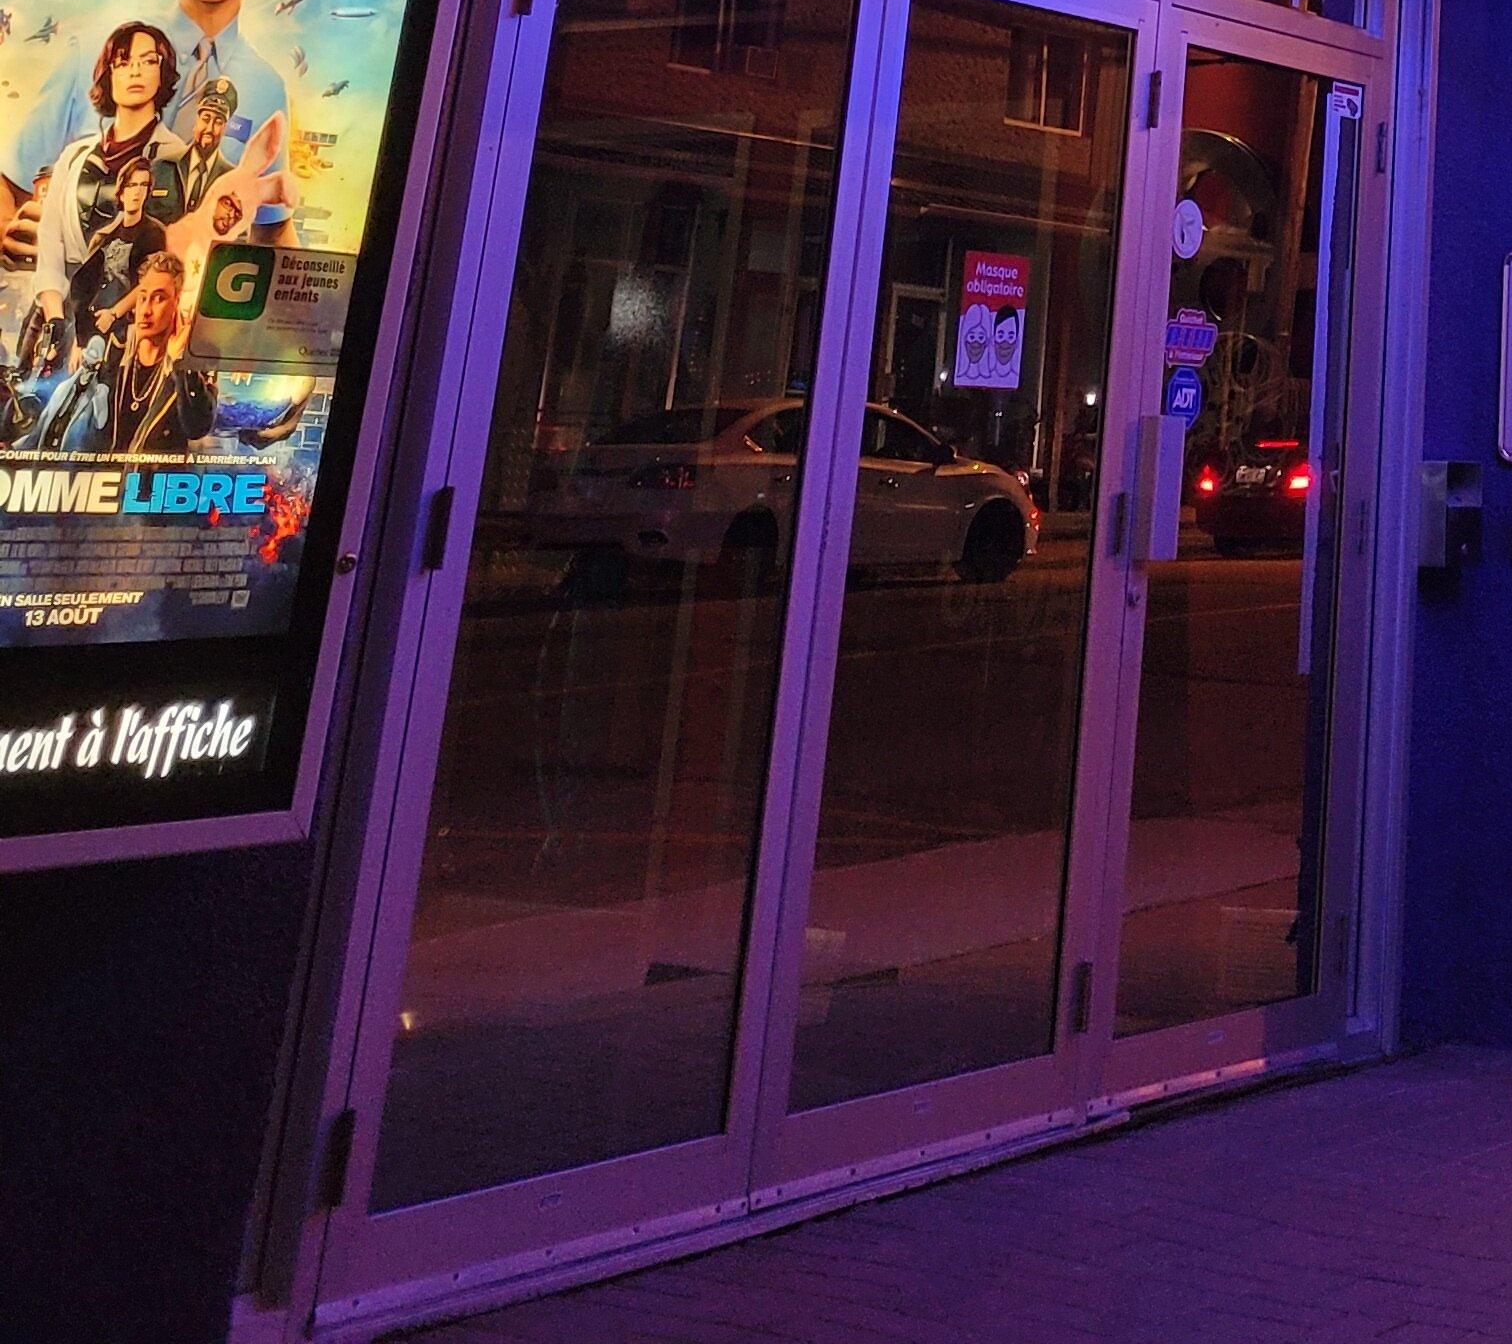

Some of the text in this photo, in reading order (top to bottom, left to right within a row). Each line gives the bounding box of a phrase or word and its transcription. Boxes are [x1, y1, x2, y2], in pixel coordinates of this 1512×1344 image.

[281, 255, 346, 274] Déconseillé
[975, 261, 1018, 280] Masque
[216, 261, 260, 303] G
[278, 273, 339, 290] aux jeunes
[966, 278, 1025, 298] obligatoire
[274, 289, 320, 304] enfants
[1172, 387, 1197, 409] ADT
[41, 451, 69, 462] POUR
[111, 453, 185, 464] PERSONNAGE
[186, 453, 195, 464] À
[122, 472, 267, 514] LIBRE
[0, 591, 144, 607] N SALLE SEULEMENT
[25, 604, 104, 627] 13 AOÛT
[76, 709, 106, 768] à
[110, 700, 255, 779] l'affiche
